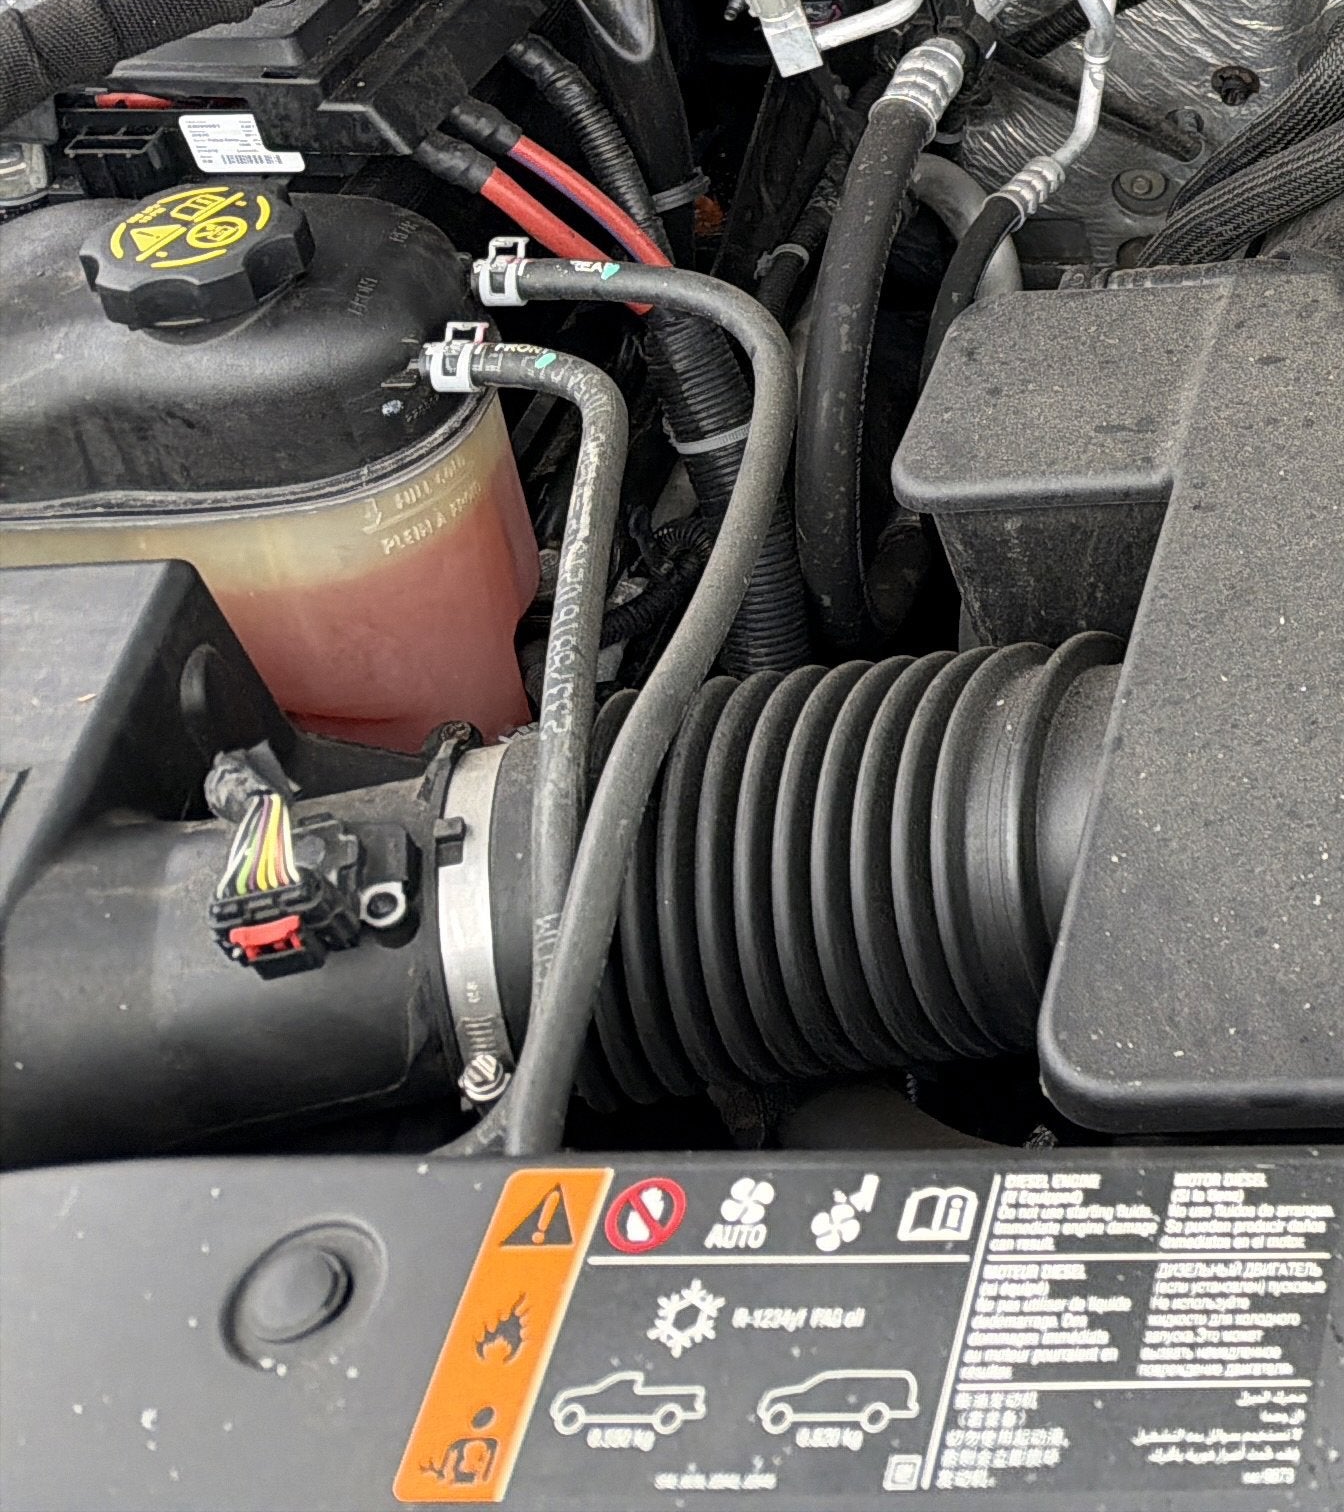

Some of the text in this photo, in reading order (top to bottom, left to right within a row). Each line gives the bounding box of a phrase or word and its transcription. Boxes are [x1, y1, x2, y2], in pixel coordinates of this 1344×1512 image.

[704, 1221, 767, 1249] AUTO
[1105, 1221, 1159, 1238] damage
[1154, 1260, 1323, 1279] ДИЗЕЛЬНЫЙ ДВИГАТЕЛЬ
